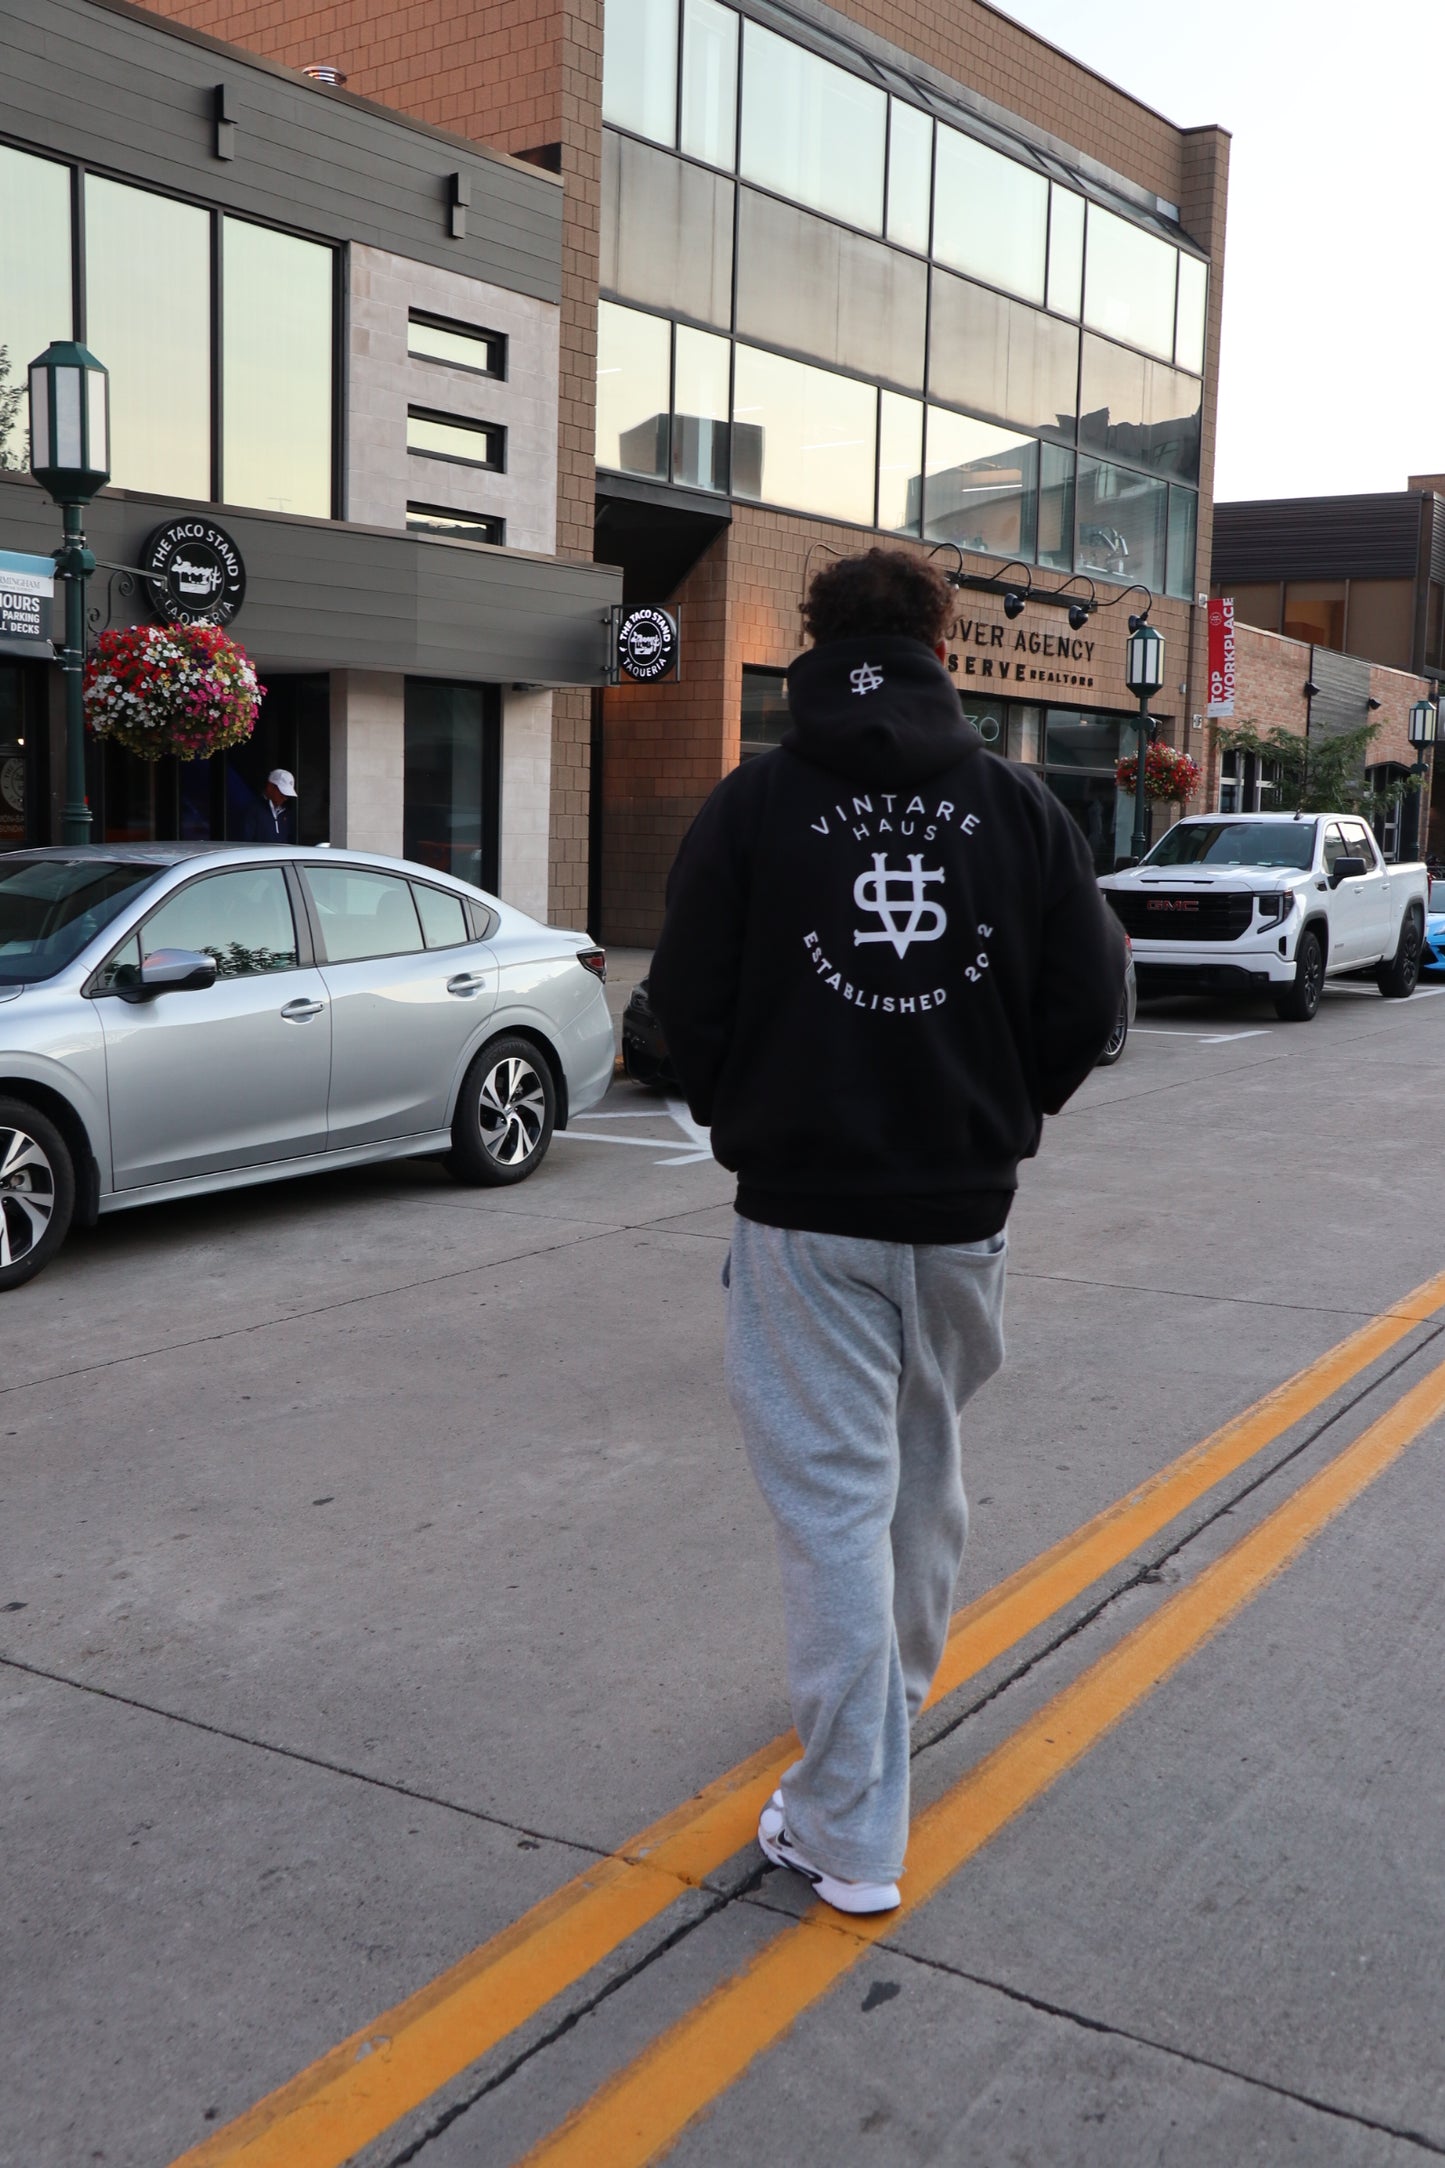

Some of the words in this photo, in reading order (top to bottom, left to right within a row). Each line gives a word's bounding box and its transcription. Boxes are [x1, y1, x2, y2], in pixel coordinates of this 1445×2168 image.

[152, 539, 172, 568] THE
[167, 524, 204, 542] TACO
[206, 530, 239, 577] STAND
[0, 593, 40, 612] OURS
[2, 609, 40, 624] PARKING
[10, 622, 40, 634] DECKS
[619, 621, 633, 640] THE
[629, 609, 652, 623] TACO
[651, 612, 671, 643] STAND
[1015, 629, 1095, 662] AGENCY
[1222, 597, 1235, 703] WORKPLACE
[623, 657, 667, 677] TAQUERIA
[1029, 669, 1094, 687] REALTORS
[1211, 671, 1223, 703] TOP
[811, 794, 981, 836] VINTARE
[852, 818, 937, 841] HAUS
[1146, 899, 1199, 911] GMC
[803, 931, 947, 1013] ESTABLISHED
